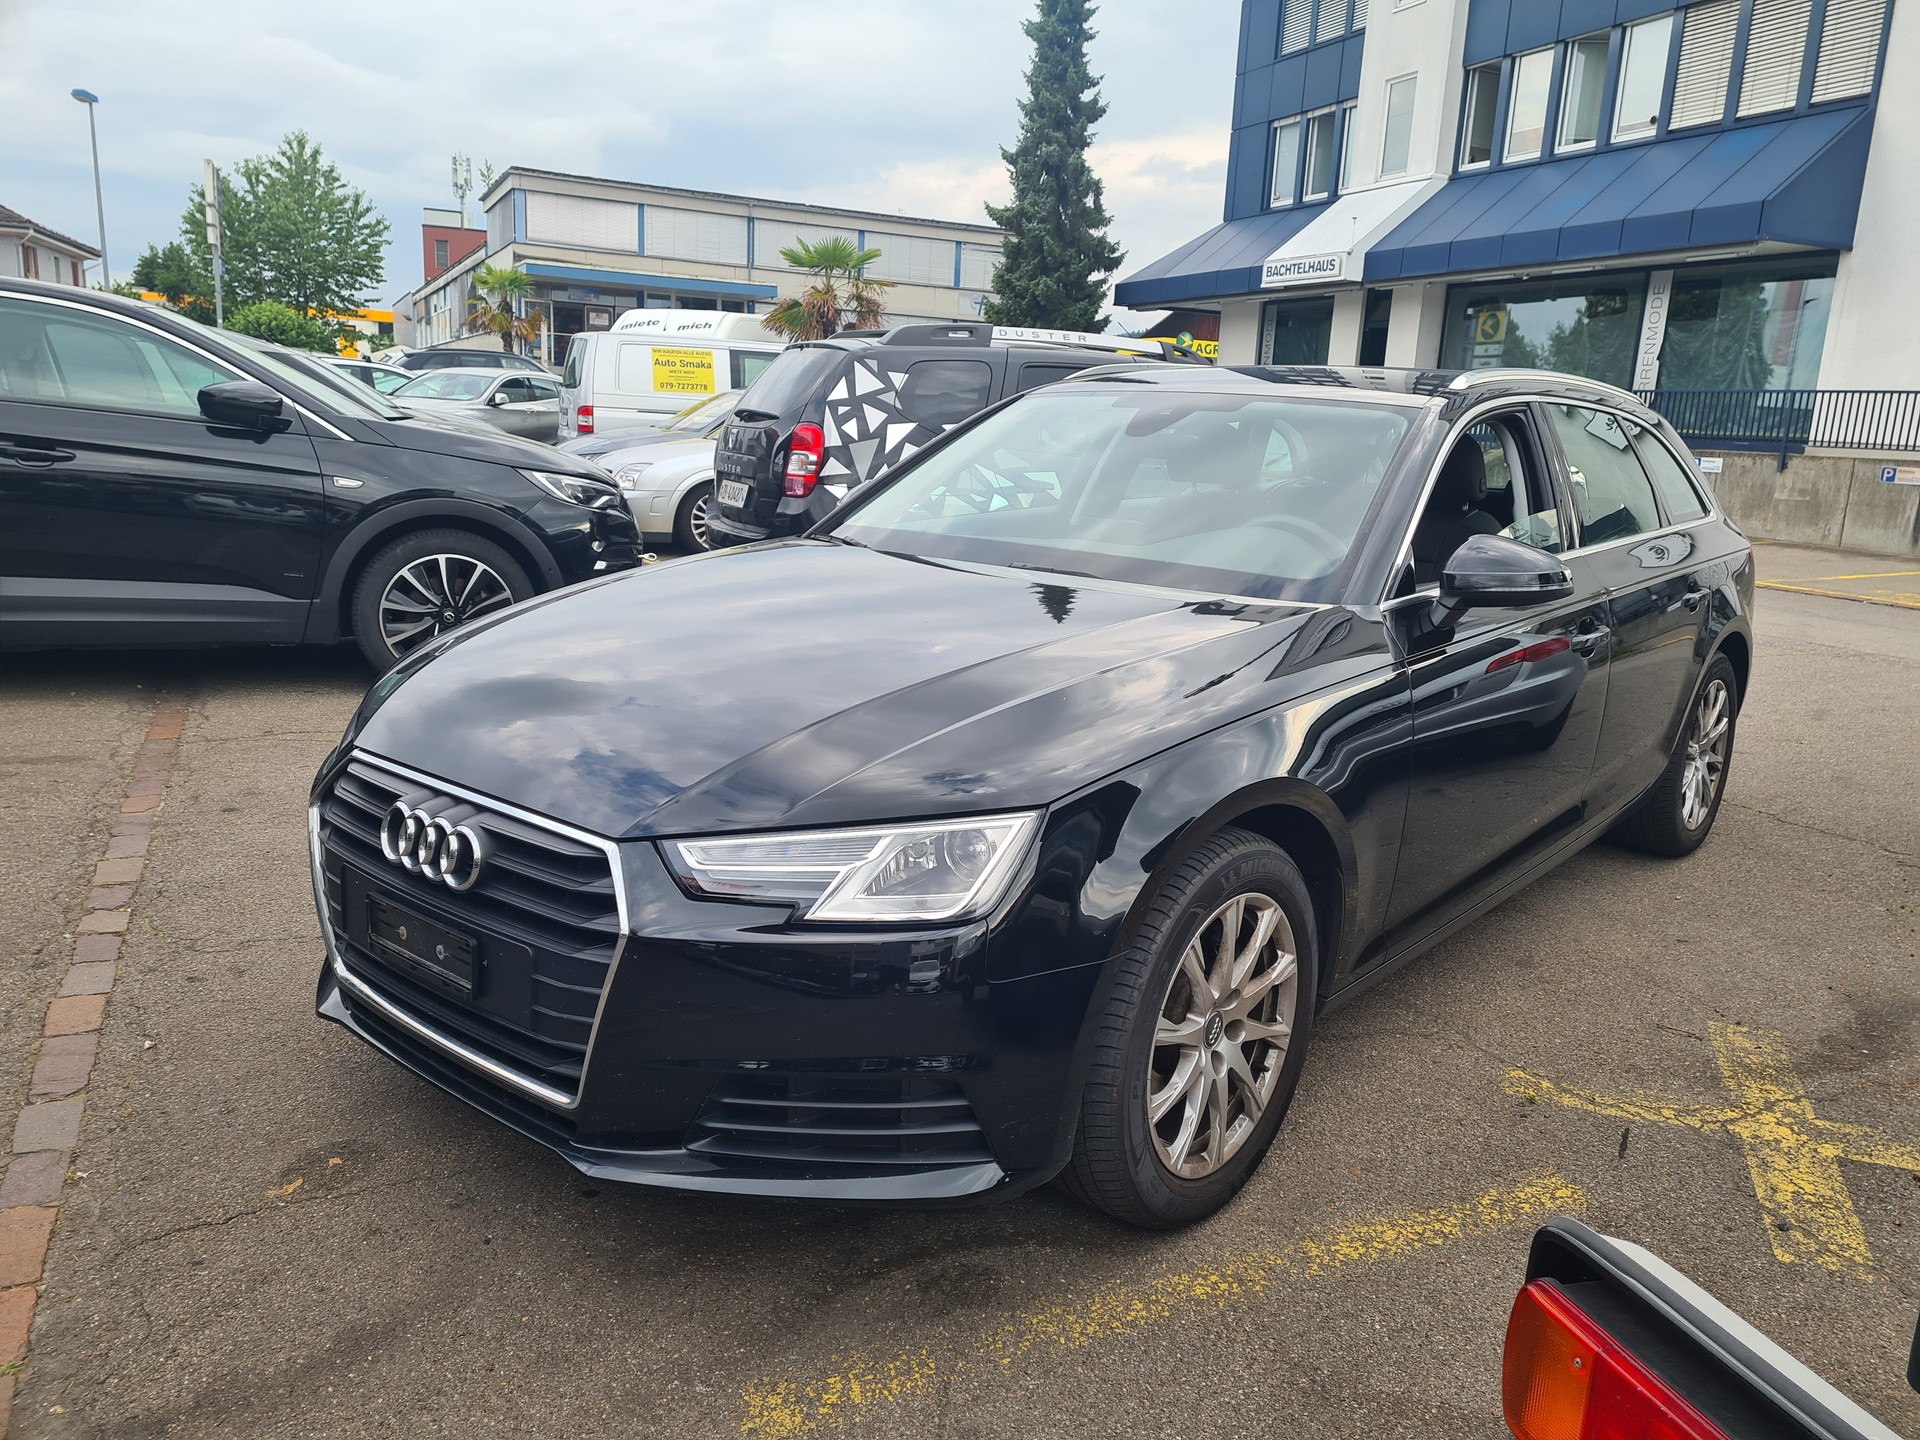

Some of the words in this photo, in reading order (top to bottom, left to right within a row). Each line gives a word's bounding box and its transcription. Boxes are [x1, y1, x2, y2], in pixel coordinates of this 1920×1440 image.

[1266, 259, 1335, 277] BACHTELHAUS
[620, 320, 660, 331] miete
[677, 322, 712, 331] mich
[999, 329, 1087, 343] DUSTER
[654, 358, 677, 368] Auto
[679, 359, 712, 369] Smaka
[659, 382, 708, 391] 079-7273778
[1882, 468, 1895, 482] P
